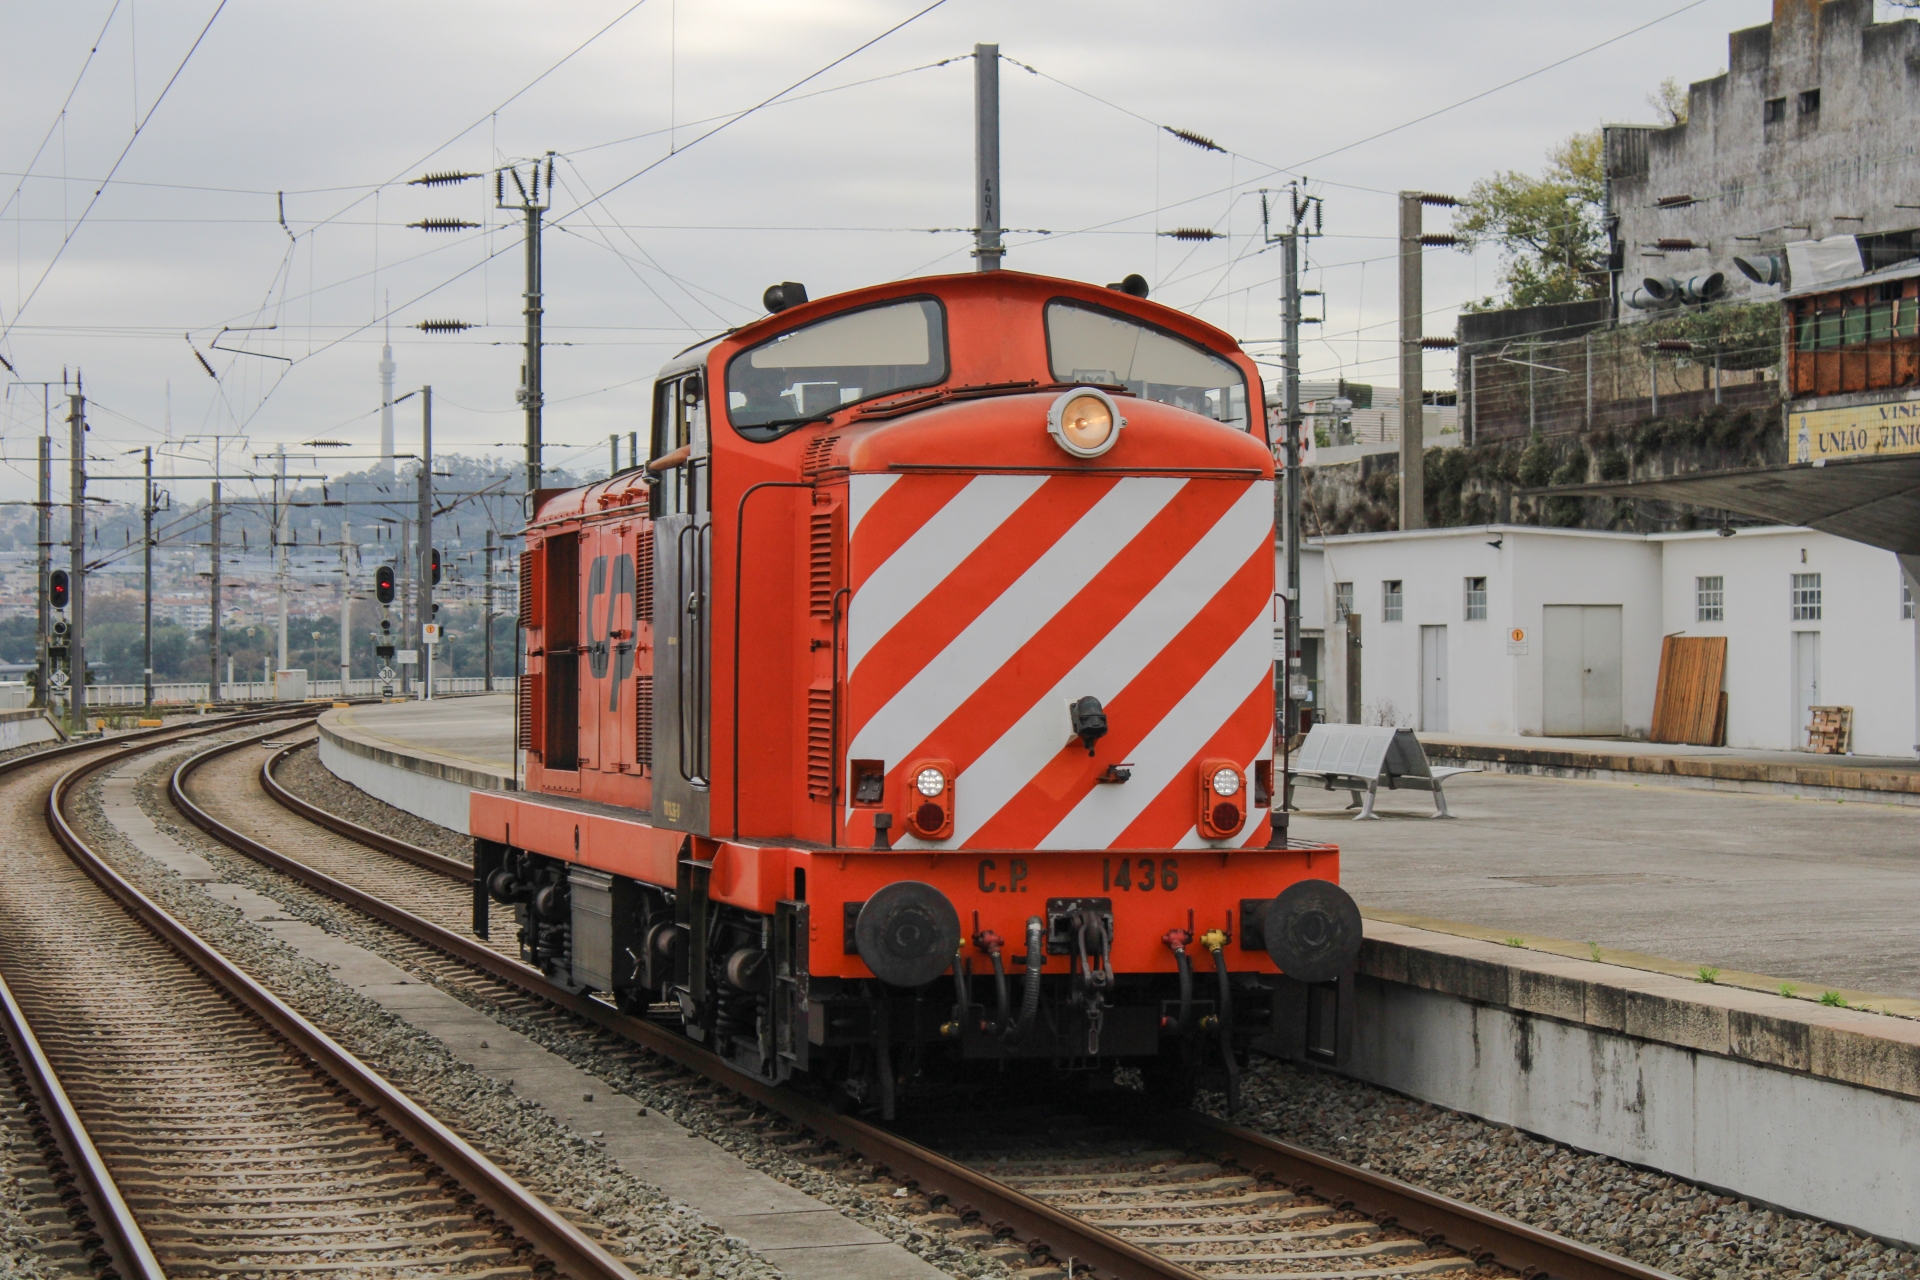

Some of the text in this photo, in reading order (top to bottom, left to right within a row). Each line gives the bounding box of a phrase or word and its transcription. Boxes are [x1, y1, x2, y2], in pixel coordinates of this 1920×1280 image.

[984, 178, 992, 223] 49A
[1818, 423, 1868, 453] UNIÃO
[54, 673, 65, 683] 30
[382, 669, 393, 679] 30
[978, 858, 1179, 893] C.P. 1436
